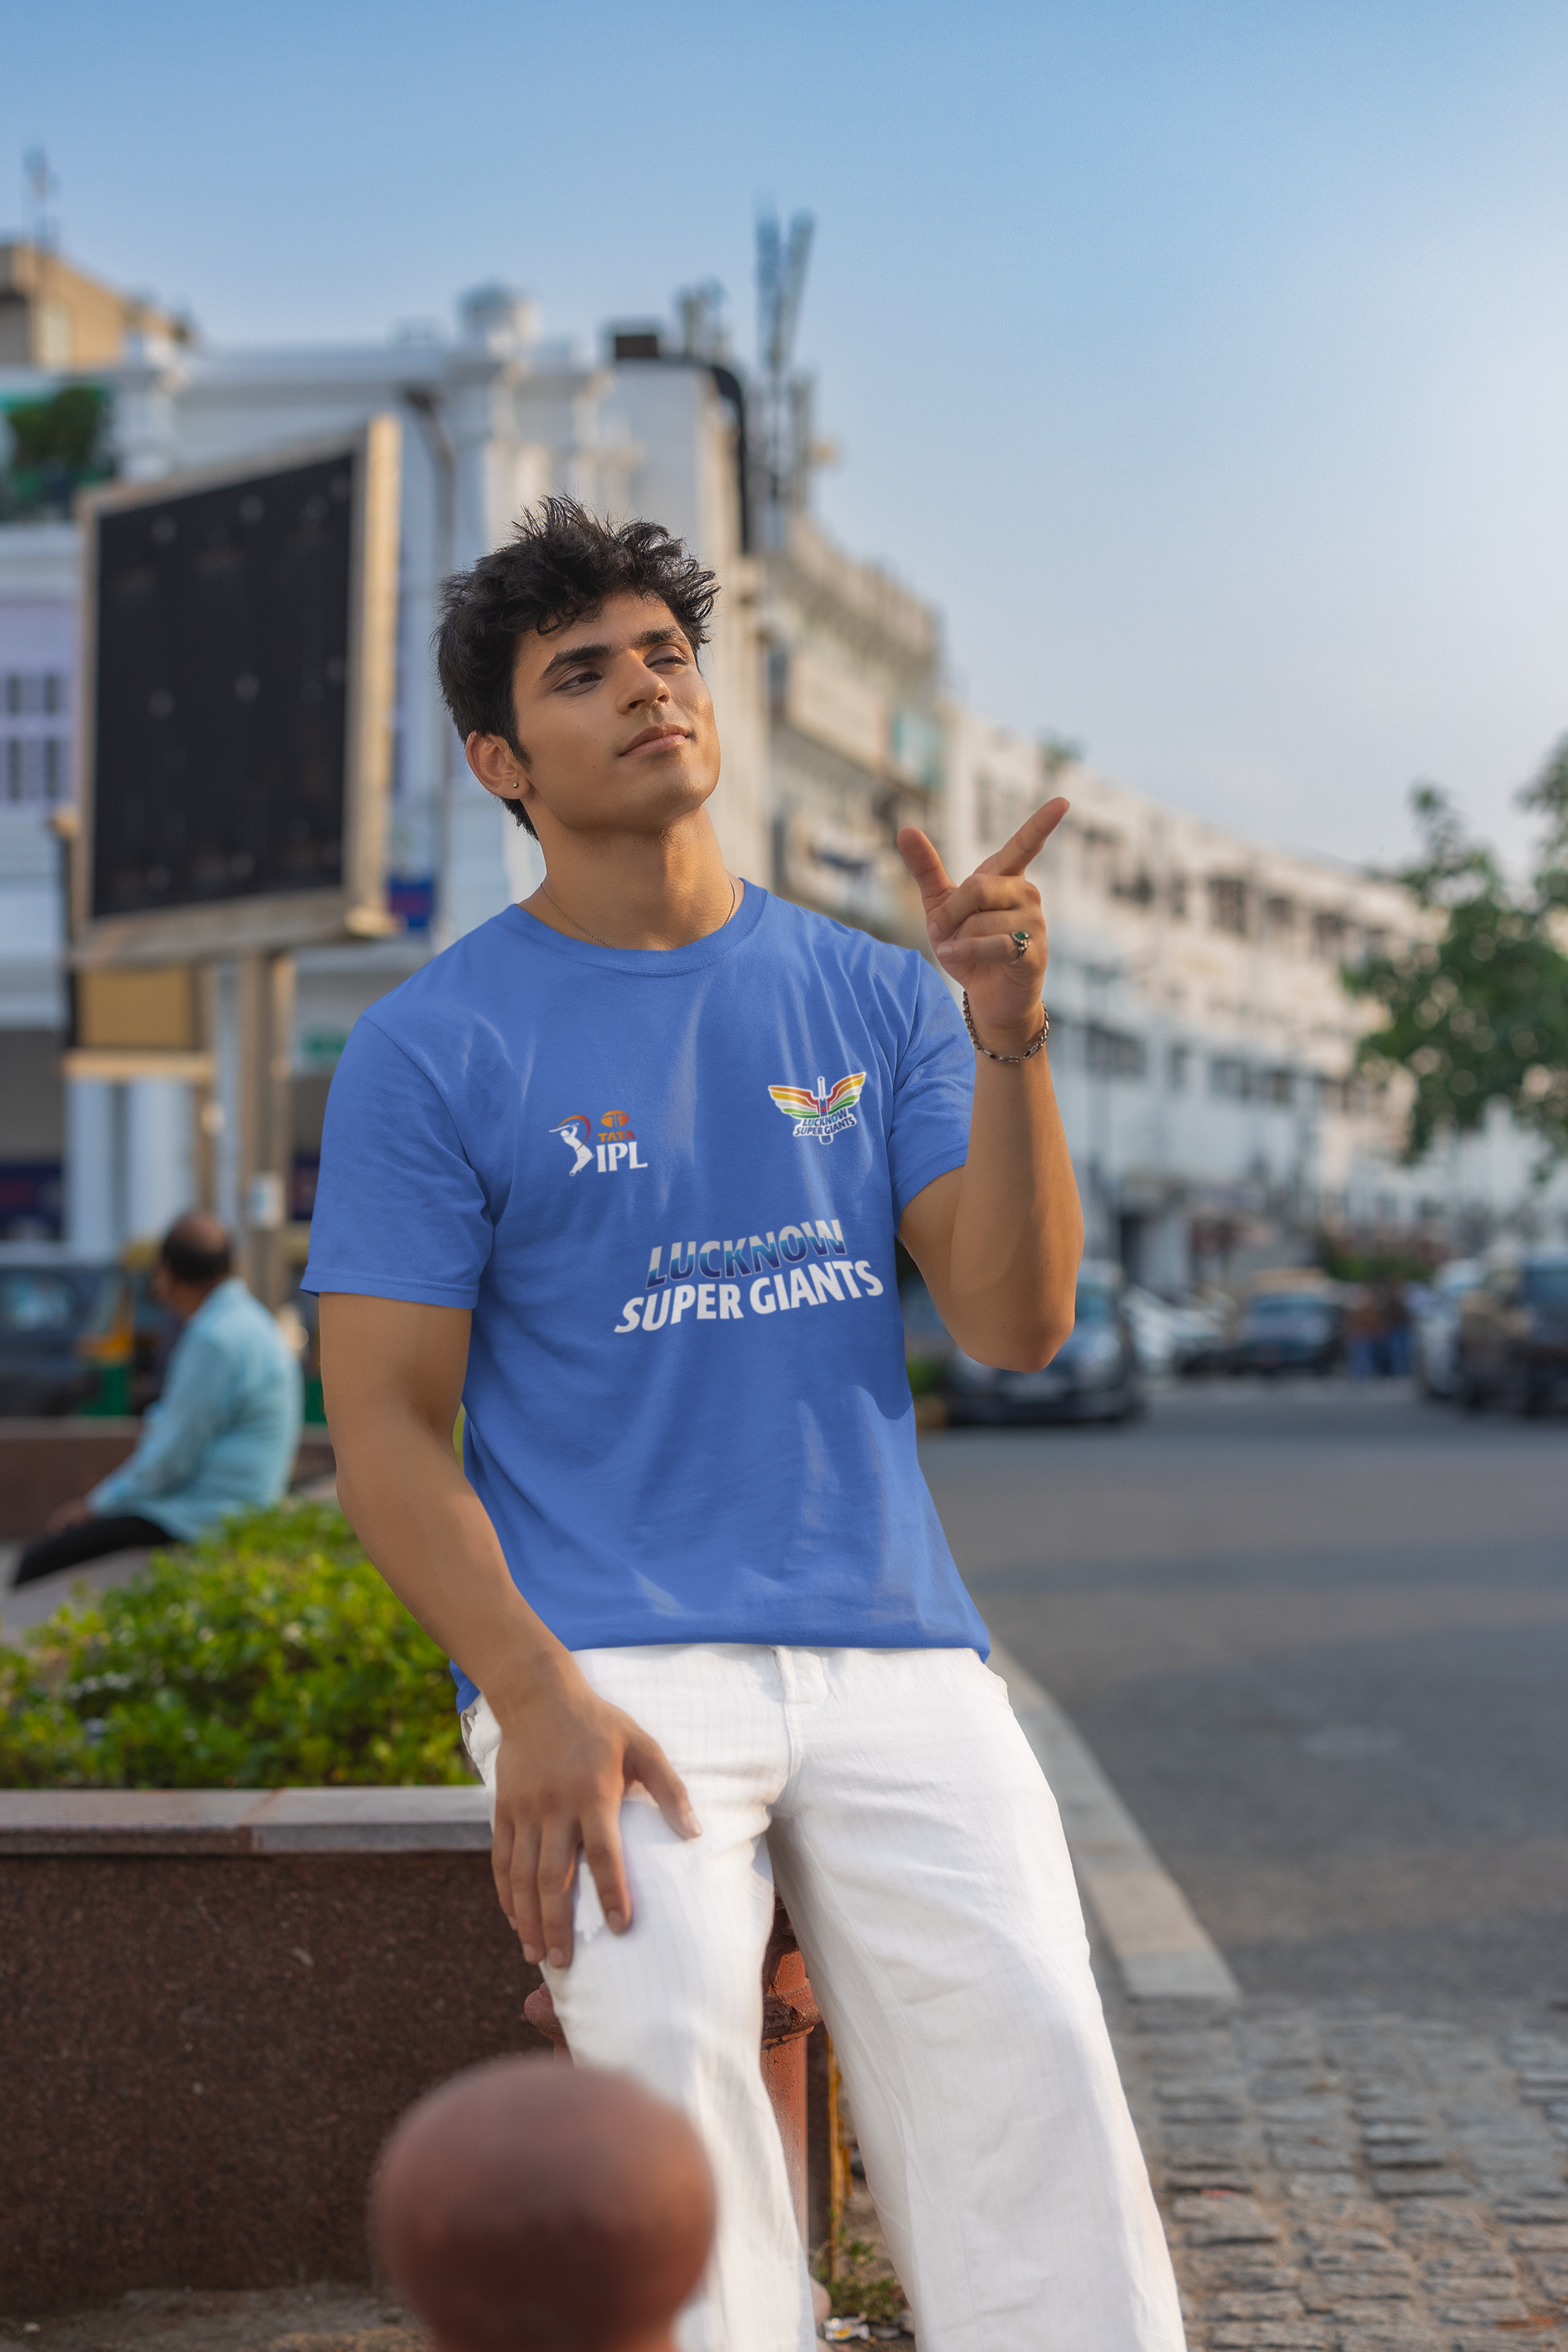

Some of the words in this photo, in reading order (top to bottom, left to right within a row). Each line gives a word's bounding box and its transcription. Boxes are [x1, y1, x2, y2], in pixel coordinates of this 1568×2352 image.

[795, 1126, 823, 1136] SUPER
[825, 1116, 855, 1135] GIANTS
[802, 1107, 848, 1127] LUCKNOW
[597, 1130, 635, 1142] TATA
[596, 1142, 648, 1173] IPL
[645, 1219, 848, 1290] LUCKNOW
[614, 1283, 744, 1333] SUPER
[750, 1260, 884, 1315] GIANTS
